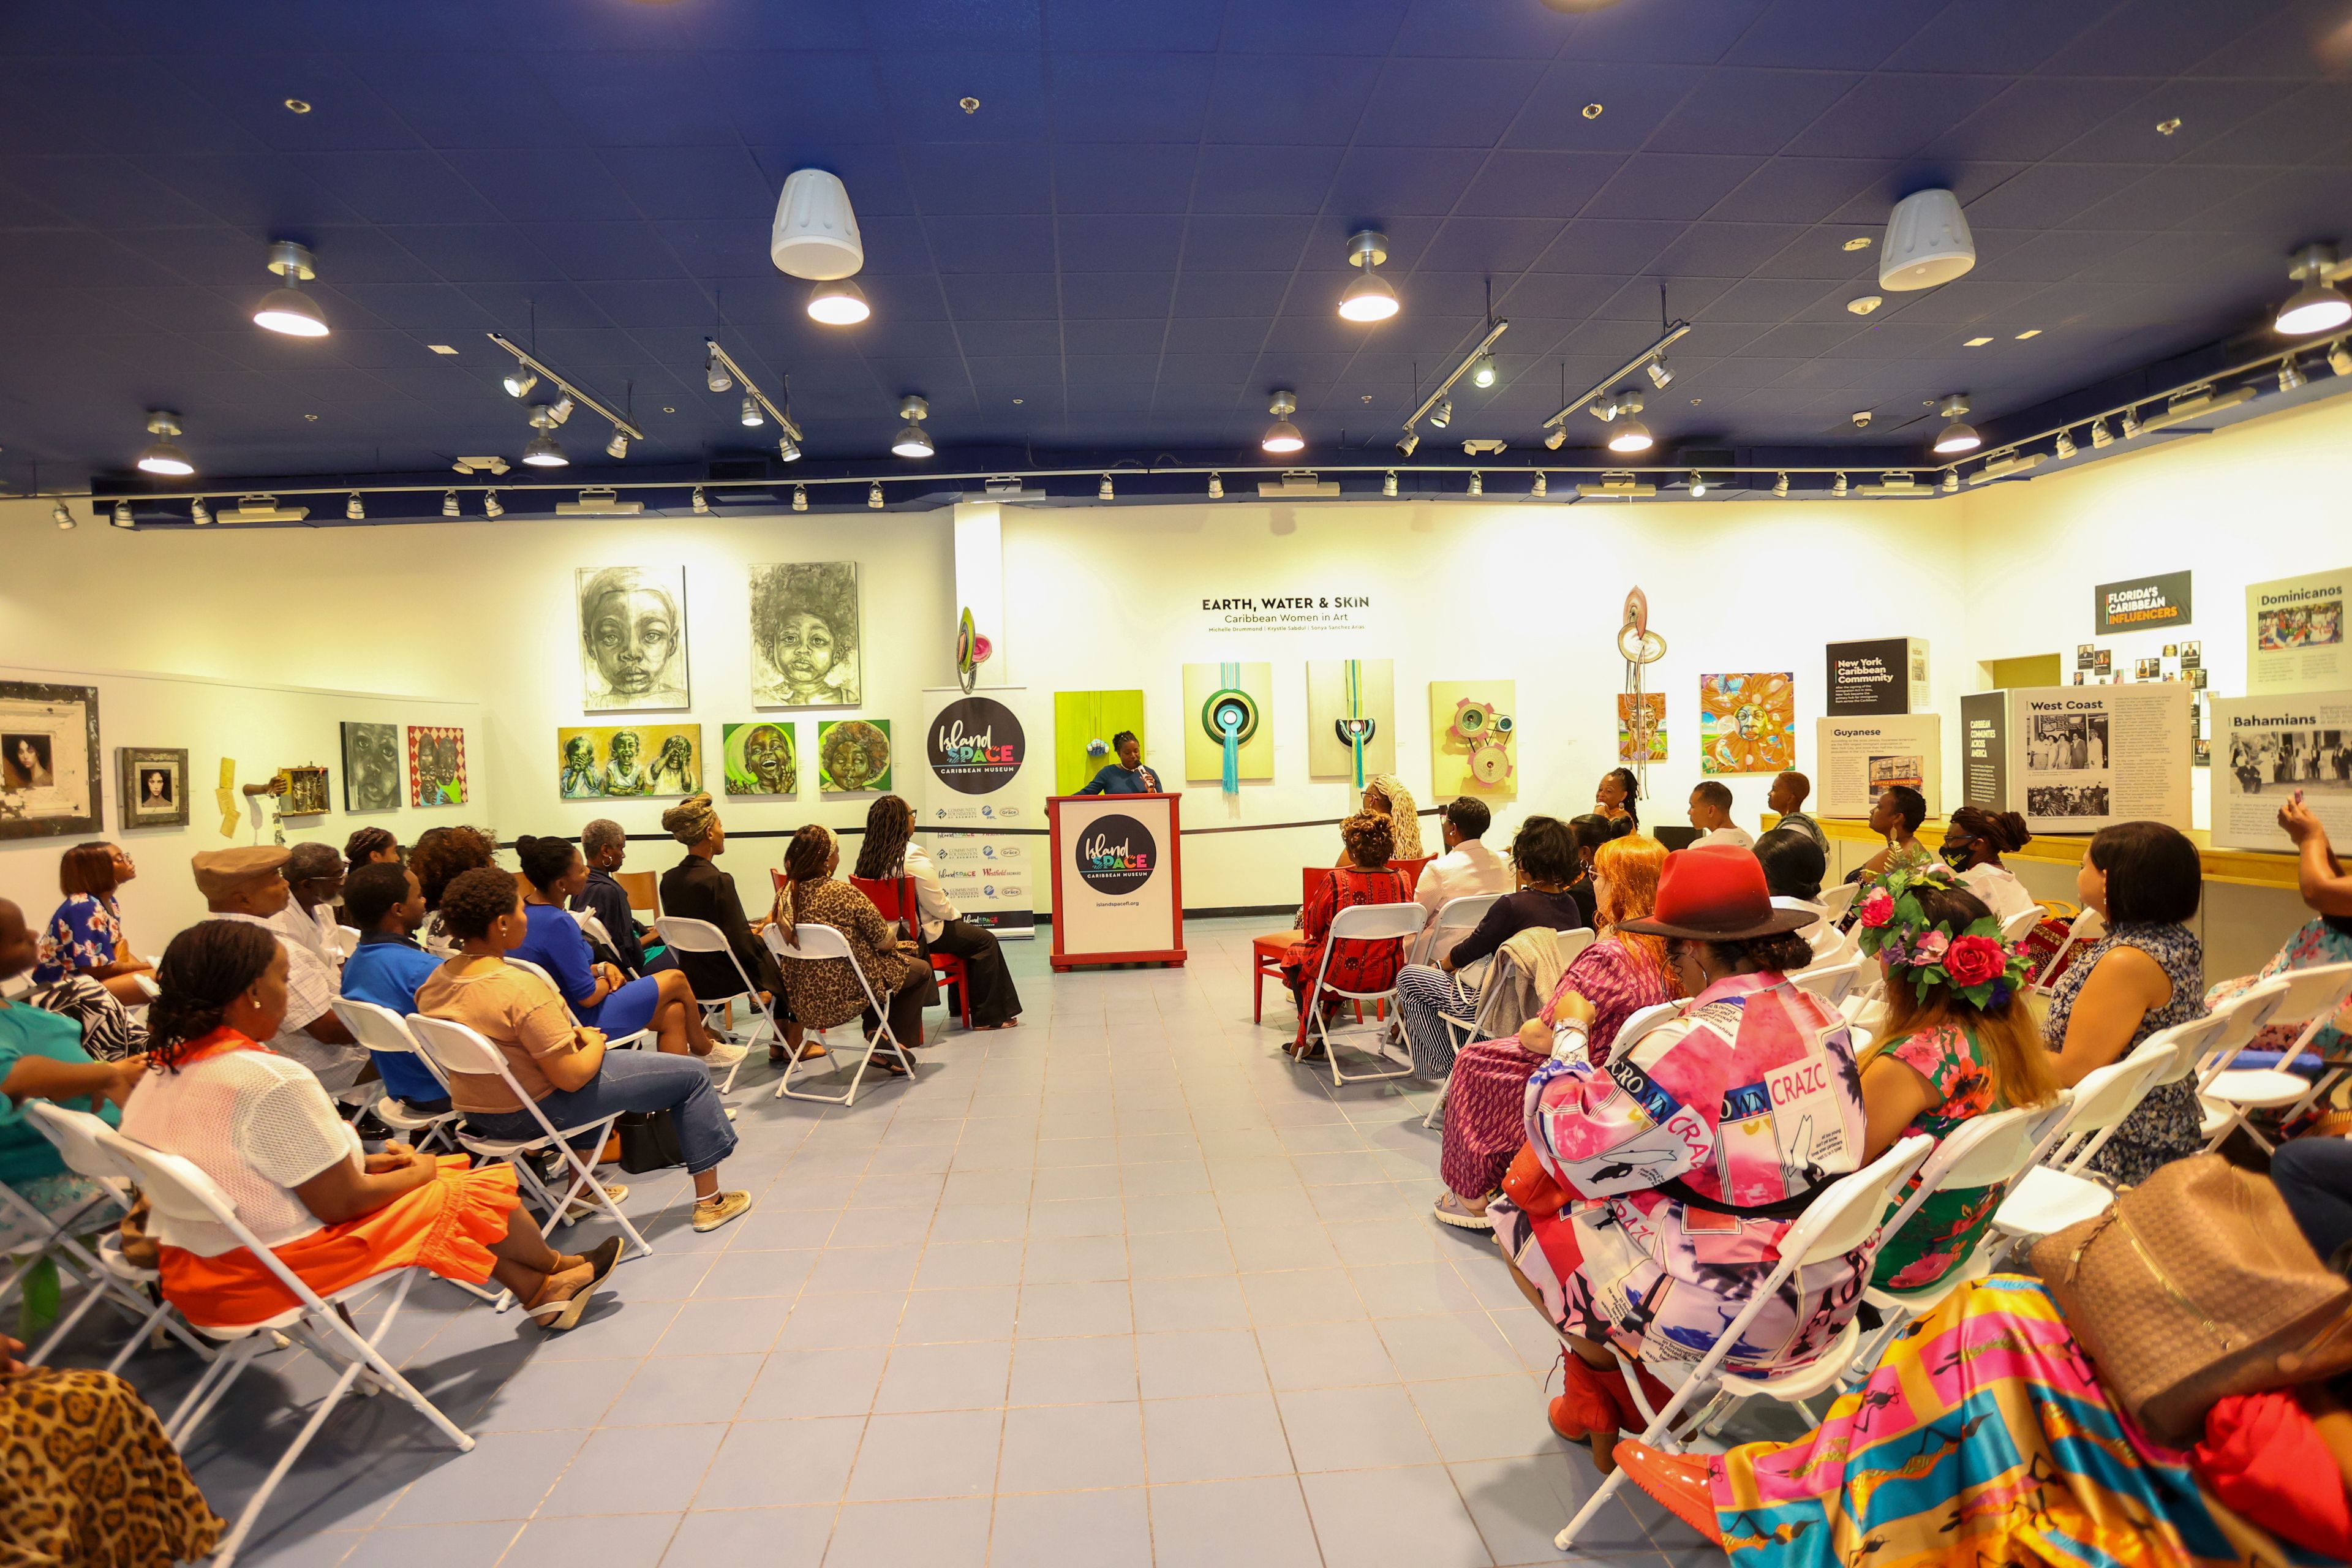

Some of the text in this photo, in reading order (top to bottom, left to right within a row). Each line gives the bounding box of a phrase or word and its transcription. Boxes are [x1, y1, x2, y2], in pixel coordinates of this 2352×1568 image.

[2108, 586, 2158, 603] FLORIDA'S
[2261, 585, 2343, 606] Dominicanos
[1202, 597, 1369, 612] EARTH, WATER & SKIN
[2108, 597, 2166, 614] CARIBBEAN
[1322, 612, 1330, 621] in
[2109, 606, 2178, 625] INFLUENCERS
[1860, 657, 1882, 666] York
[1838, 666, 1886, 676] Caribbean
[1838, 673, 1894, 683] Community
[2030, 700, 2103, 710] West Coast
[1970, 720, 1991, 729] CARIBBEAN
[2234, 714, 2316, 726] Bahamians
[938, 720, 992, 753] Island
[1834, 729, 1881, 737] Guyanese
[1970, 729, 1996, 739] COMMUNITIES
[1970, 739, 1986, 748] ACROSS
[947, 745, 1014, 763] SPACE
[1970, 749, 1988, 758] AMERICA
[1085, 833, 1129, 861] Island
[1092, 854, 1147, 869] SPACE
[982, 868, 1006, 876] Westfield
[1610, 1060, 1673, 1120] CROWN
[1771, 1063, 1826, 1106] CRAZC
